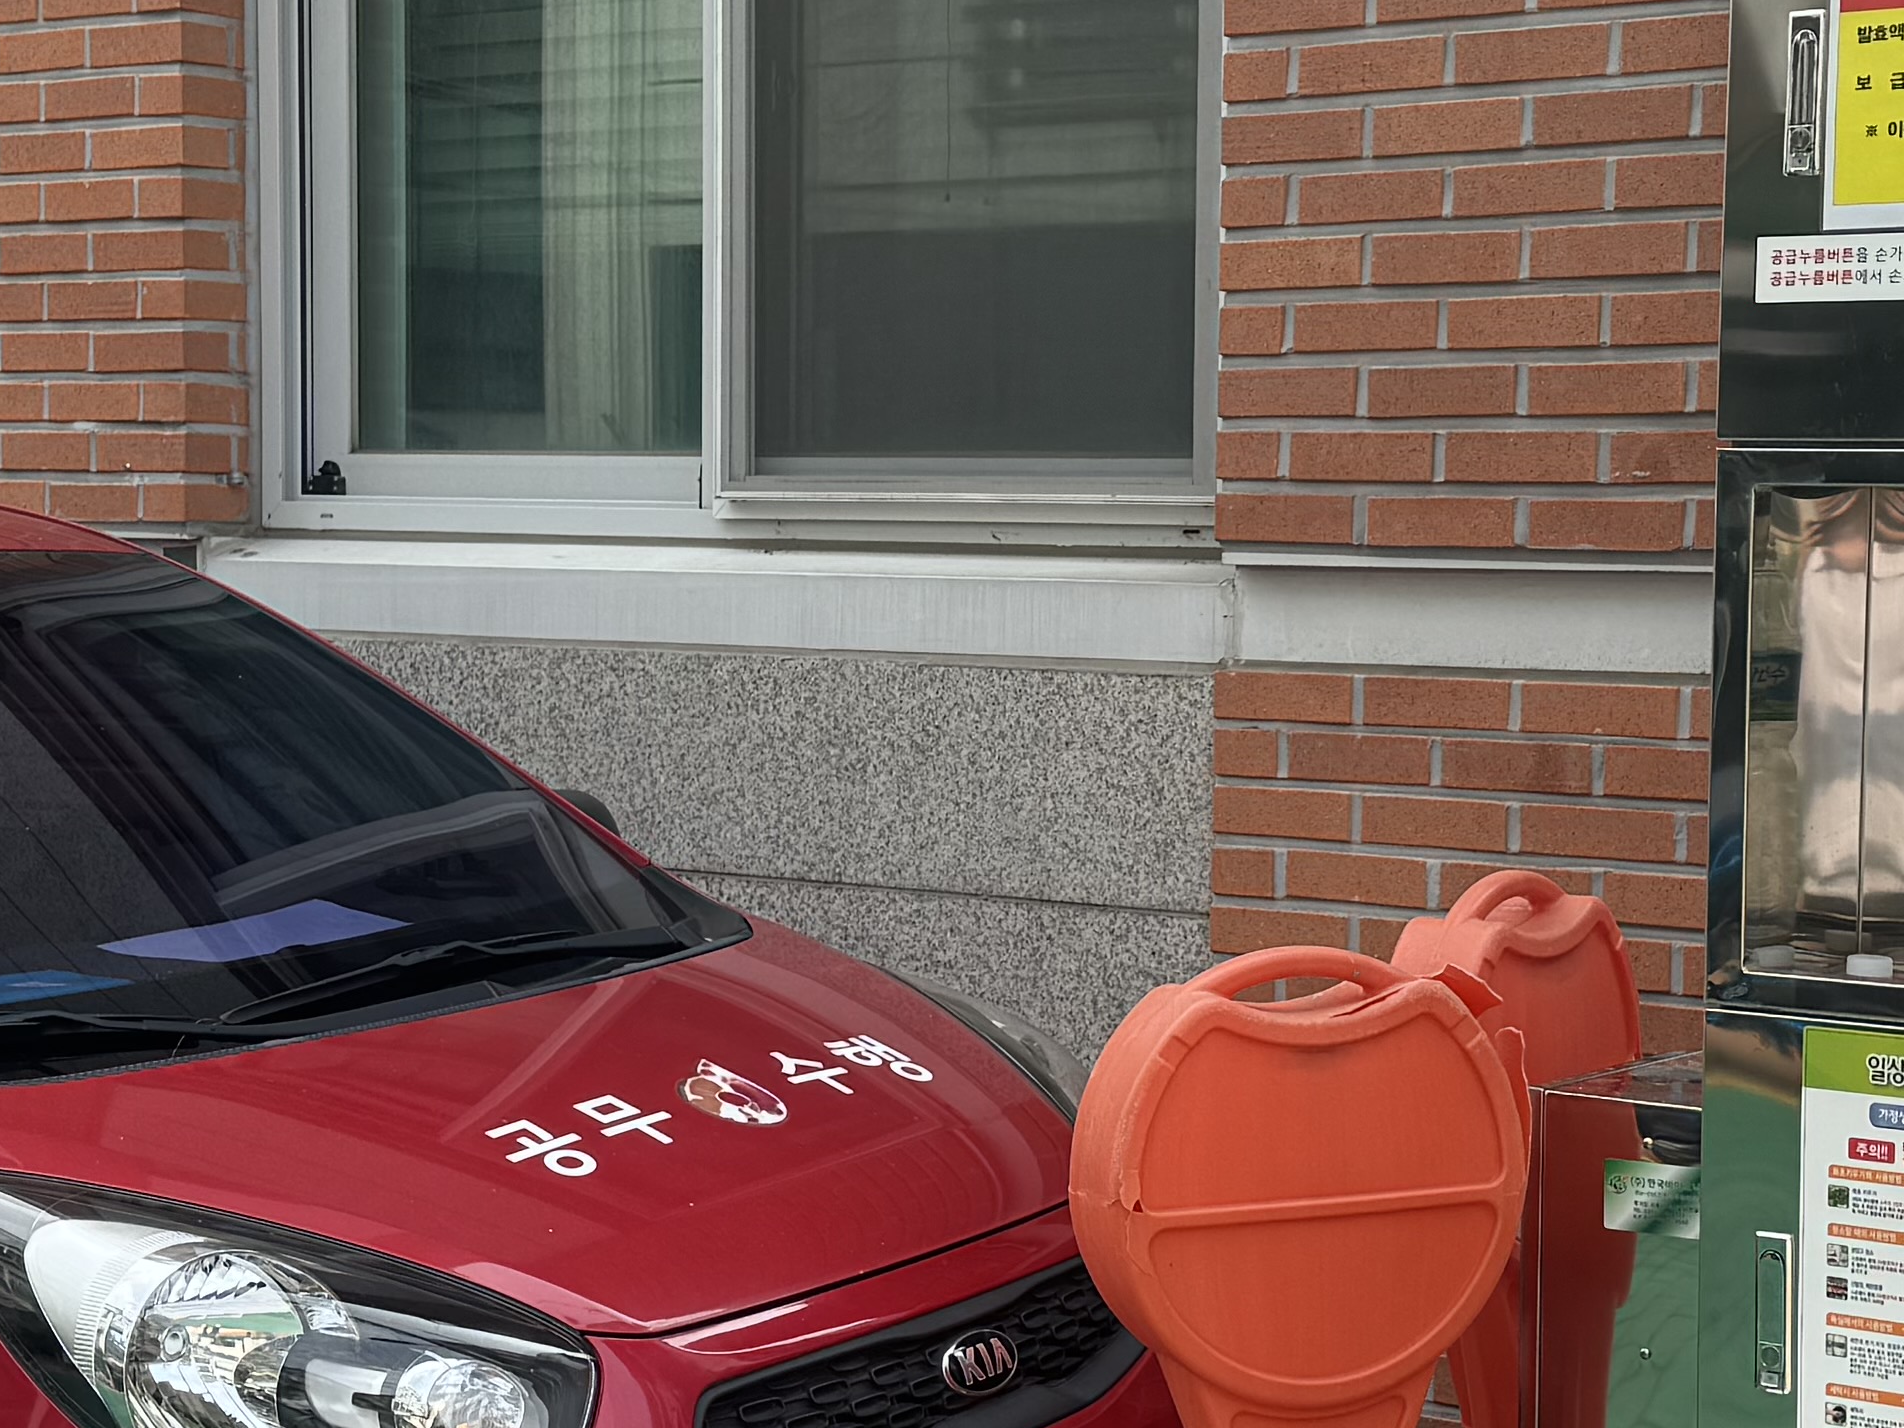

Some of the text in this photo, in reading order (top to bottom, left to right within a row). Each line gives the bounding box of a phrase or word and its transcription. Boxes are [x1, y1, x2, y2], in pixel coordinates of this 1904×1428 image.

[1857, 22, 1904, 43] 발효액
[1770, 245, 1869, 265] 공급누름버튼을
[1769, 269, 1882, 287] 공급누름버튼에서
[485, 1033, 933, 1176] 공무 수행
[1856, 1143, 1889, 1161] 주의!!
[957, 1336, 1013, 1384] KIA
